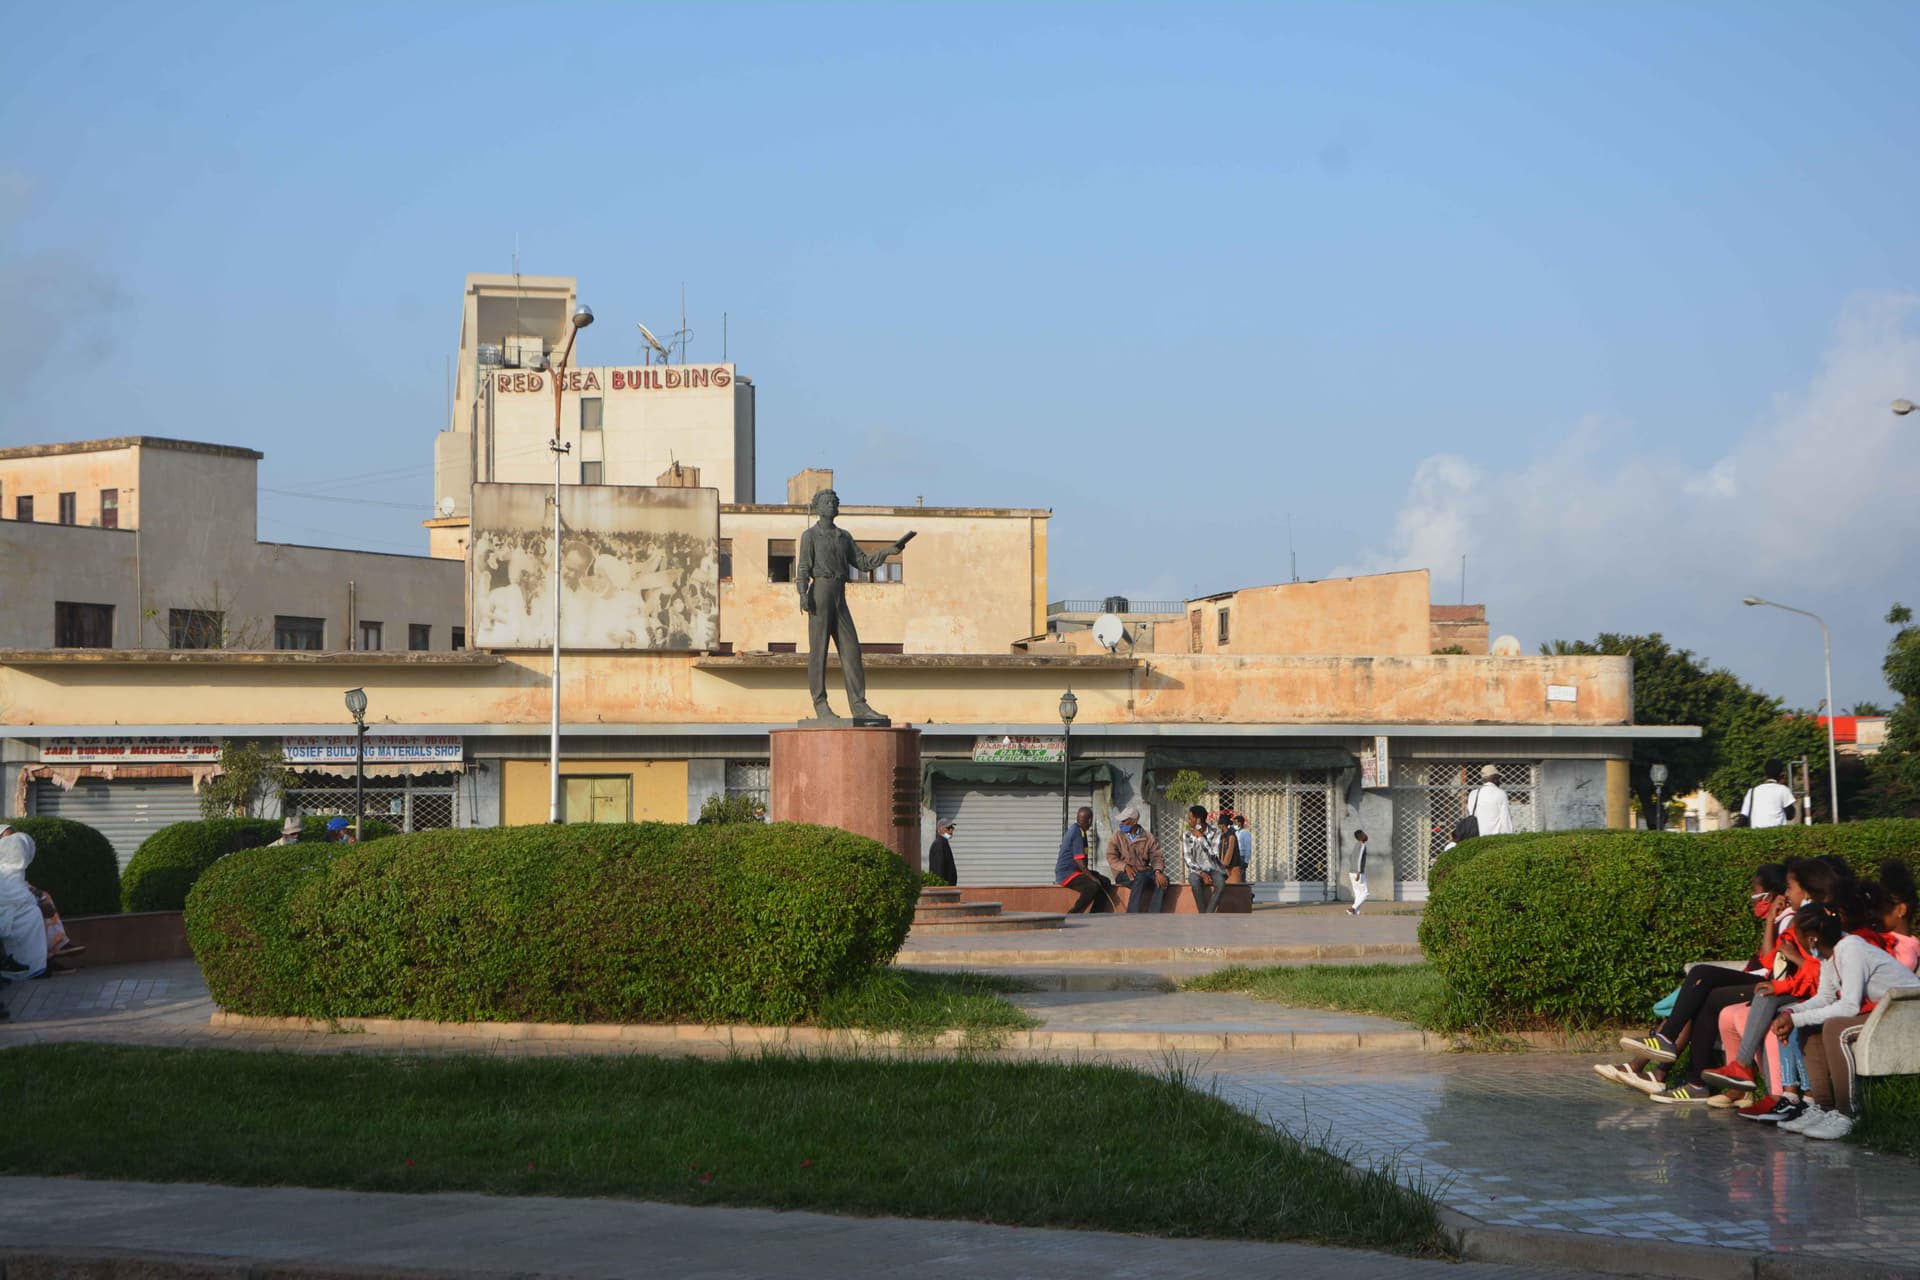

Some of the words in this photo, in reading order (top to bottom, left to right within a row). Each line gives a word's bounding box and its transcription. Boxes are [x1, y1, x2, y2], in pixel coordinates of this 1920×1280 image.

[497, 372, 544, 393] RED
[612, 367, 731, 390] BUILDING
[44, 746, 73, 755] SAMI
[77, 746, 125, 755] BUILDING
[129, 746, 188, 755] MATERIALS
[192, 745, 219, 754] SHOP
[287, 746, 323, 757] YOSIEF
[326, 746, 375, 757] BUILDNG
[378, 746, 432, 757] MATERIALS
[435, 745, 460, 756] SHOP
